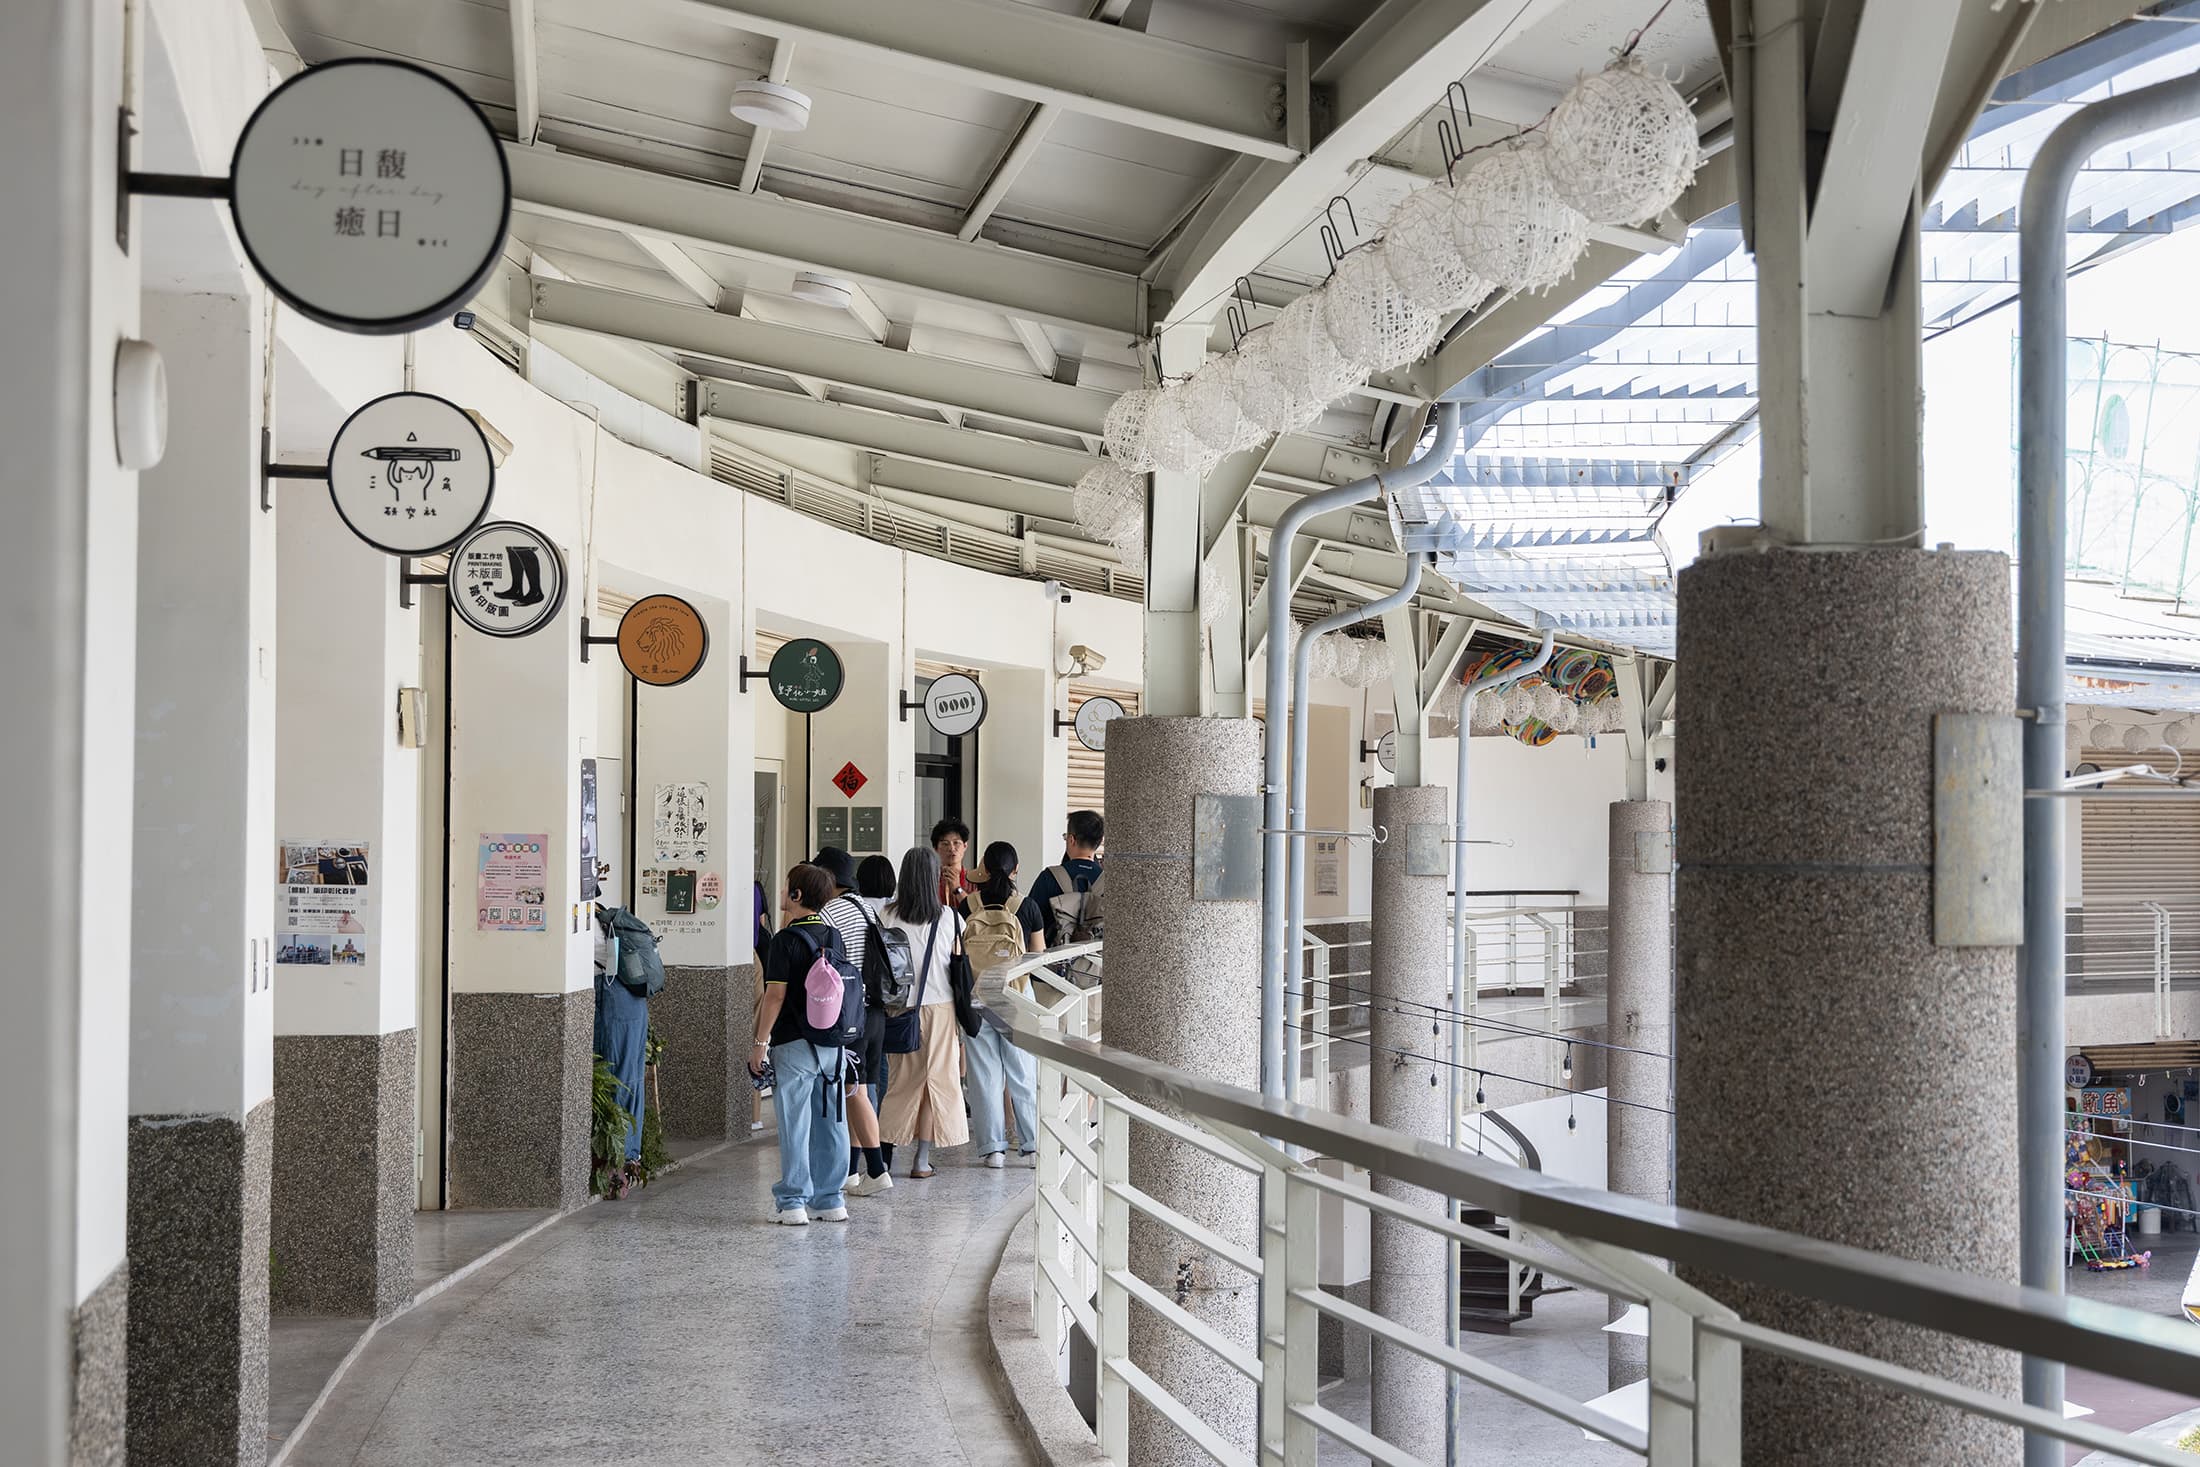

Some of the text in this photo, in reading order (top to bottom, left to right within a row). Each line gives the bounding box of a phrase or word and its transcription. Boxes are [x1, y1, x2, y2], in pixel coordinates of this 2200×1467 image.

[339, 148, 406, 179] 日馥
[335, 206, 401, 238] 癒日
[840, 768, 859, 792] 福
